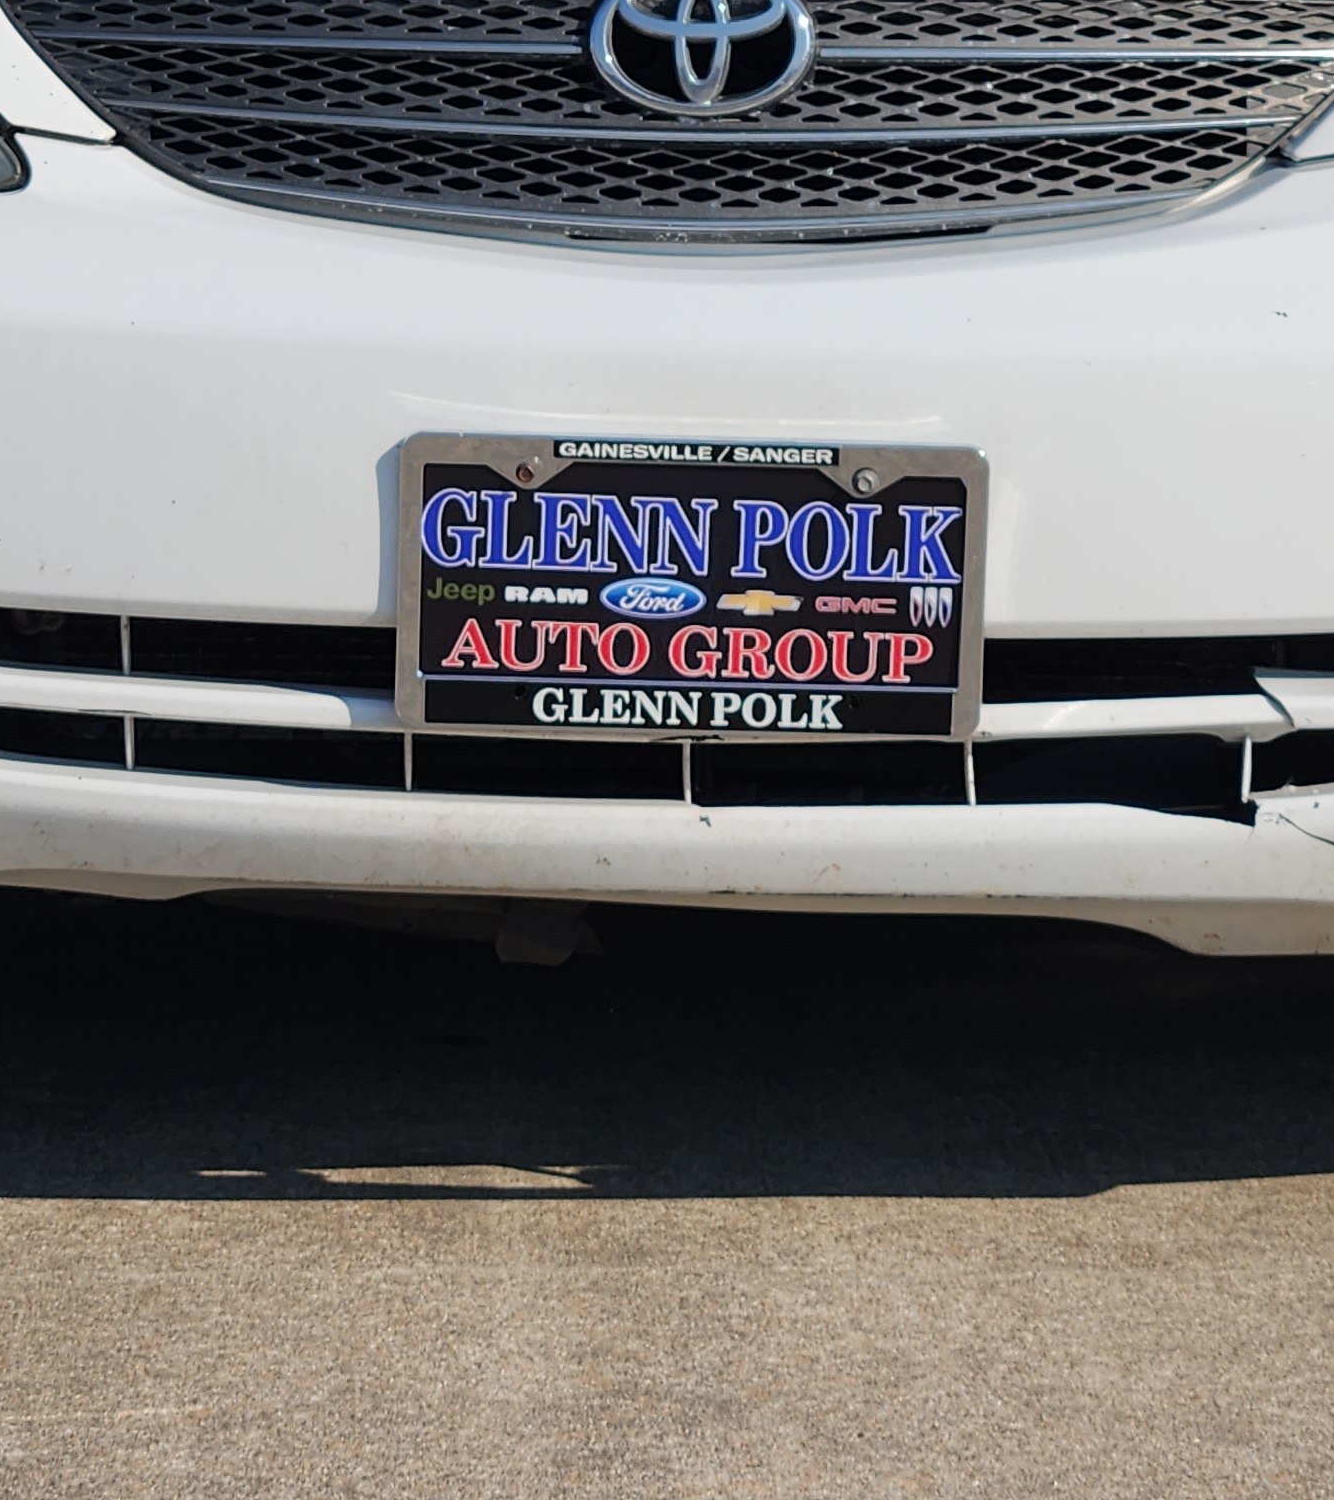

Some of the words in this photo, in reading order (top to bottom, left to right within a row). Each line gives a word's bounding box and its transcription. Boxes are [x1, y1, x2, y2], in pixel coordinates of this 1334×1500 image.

[559, 442, 712, 463] GAINESVILLE
[733, 446, 834, 465] SANGER
[420, 486, 718, 576] GLENN
[730, 499, 964, 585] POLK
[427, 577, 496, 606] Jeep
[504, 585, 588, 605] RAM
[618, 584, 686, 613] Ford
[815, 595, 898, 615] GMC
[441, 618, 651, 674] AUTO
[668, 624, 935, 684] GROUP
[532, 686, 701, 727] GLENN
[708, 692, 844, 730] POLK
